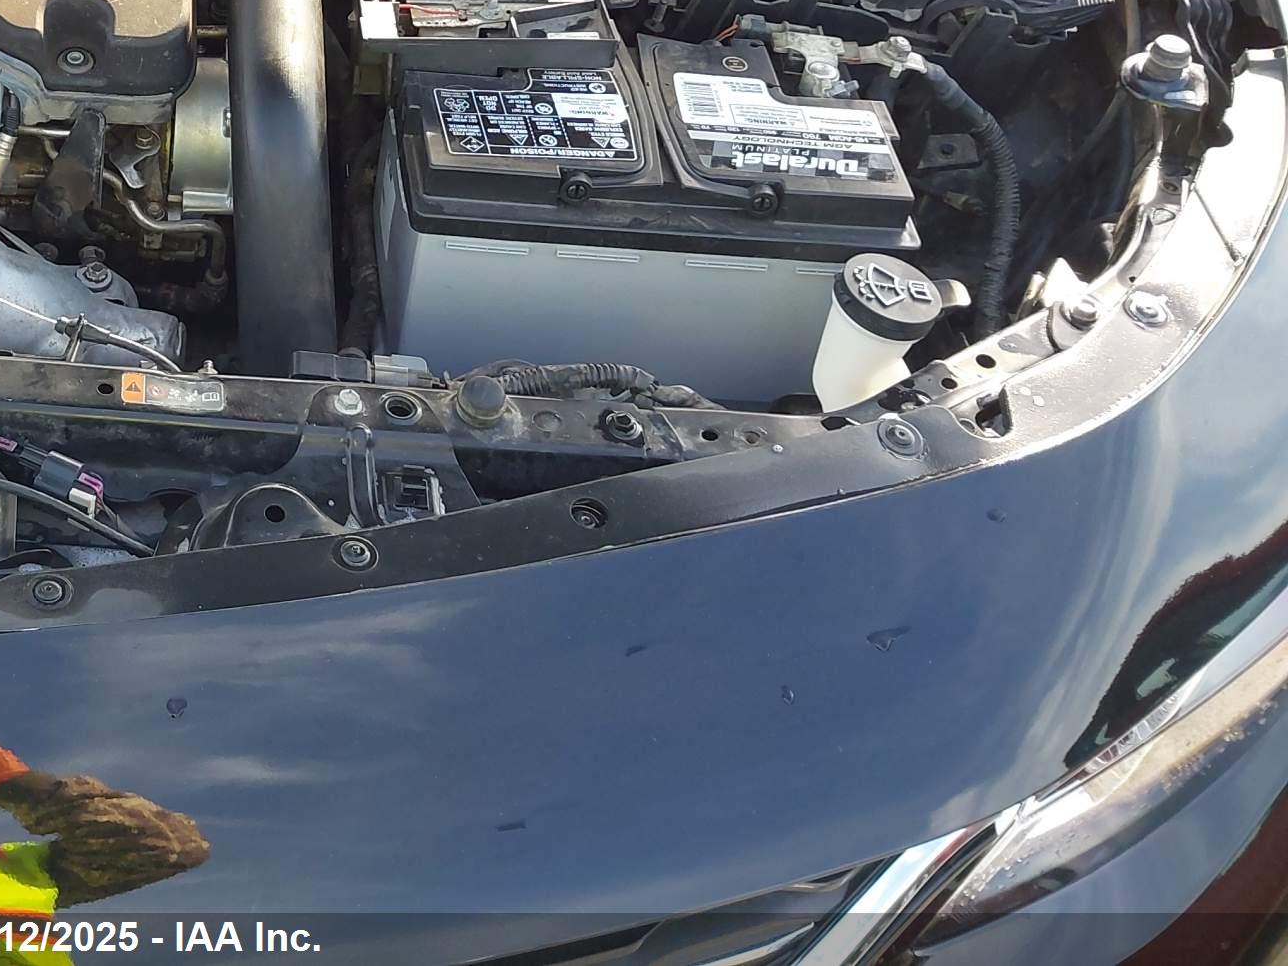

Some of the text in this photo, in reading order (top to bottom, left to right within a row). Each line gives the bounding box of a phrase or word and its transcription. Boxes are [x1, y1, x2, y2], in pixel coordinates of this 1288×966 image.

[732, 135, 819, 147] TECHNOLOGY
[510, 148, 606, 158] DANGER/POISON
[731, 143, 810, 156] PLATINUM
[730, 151, 868, 176] Duralast
